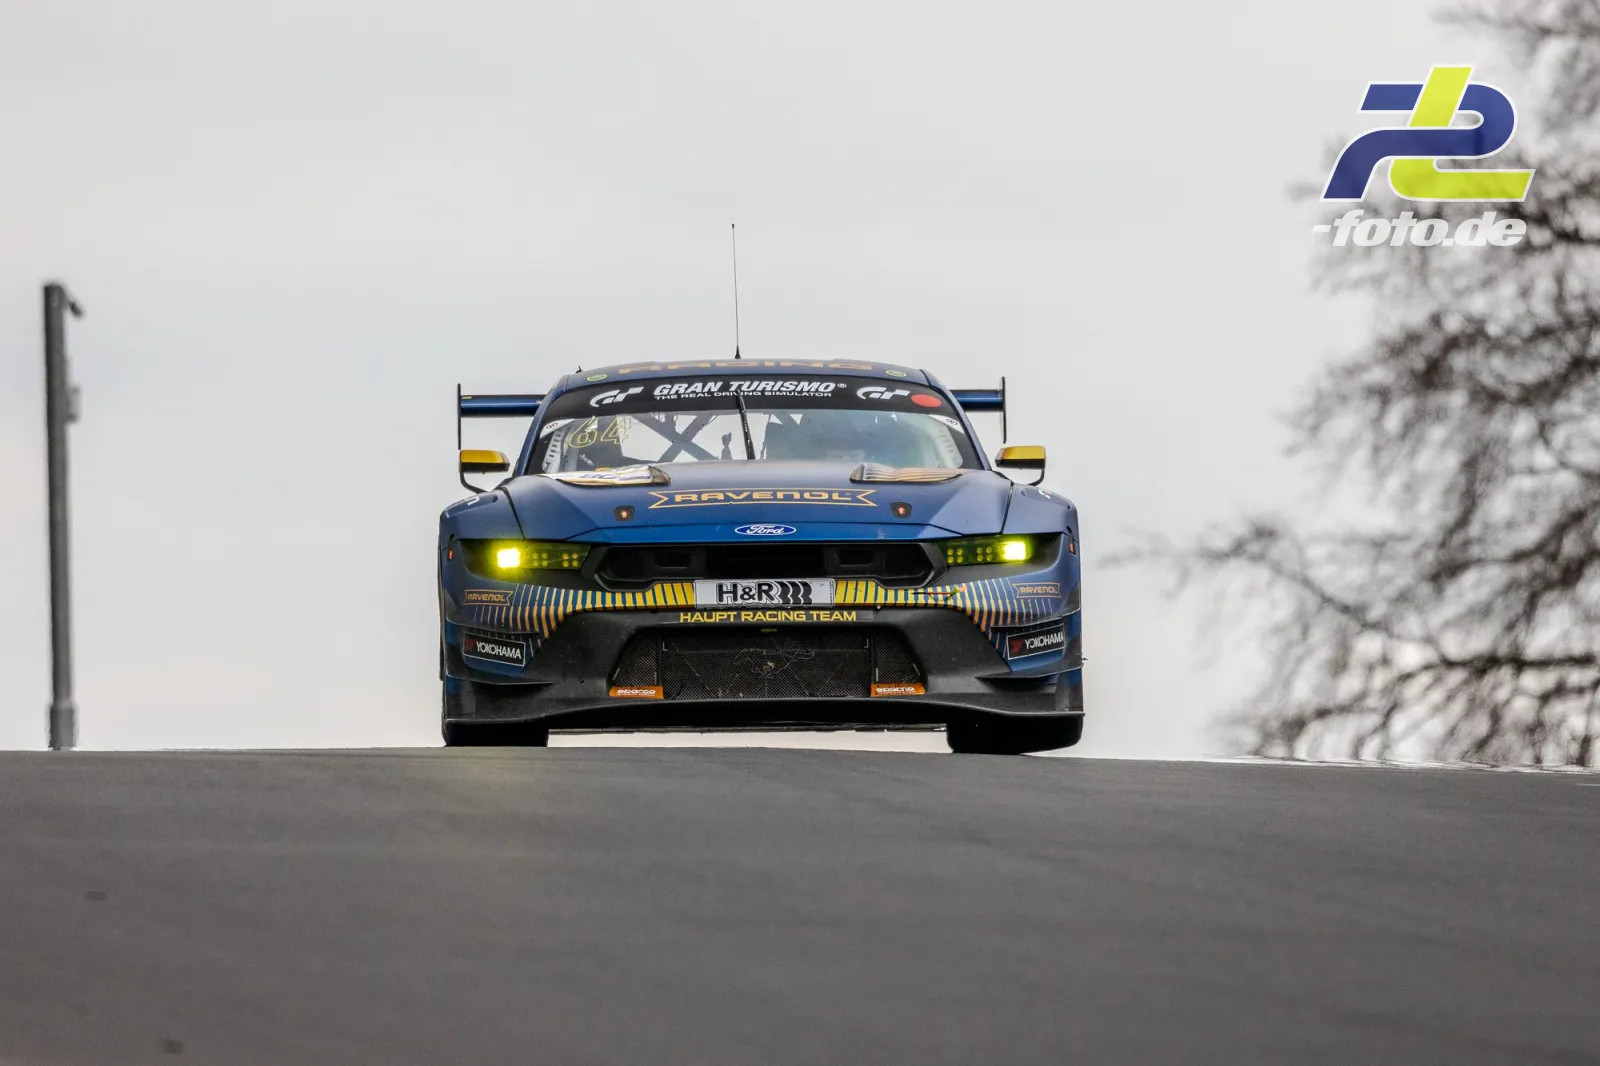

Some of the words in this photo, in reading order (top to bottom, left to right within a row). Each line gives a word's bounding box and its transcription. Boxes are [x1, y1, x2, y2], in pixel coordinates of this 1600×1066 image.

[653, 381, 724, 396] GRAN
[568, 417, 632, 448] 64
[675, 491, 852, 502] RAVENOL
[746, 525, 784, 534] Ford
[716, 582, 779, 605] H&R
[1019, 586, 1058, 594] RAVENOL
[467, 593, 506, 602] RAVENOL
[680, 612, 736, 623] HAUPT
[741, 611, 806, 621] RACING
[810, 611, 857, 621] TEAM
[476, 640, 522, 660] YOKOHAMA
